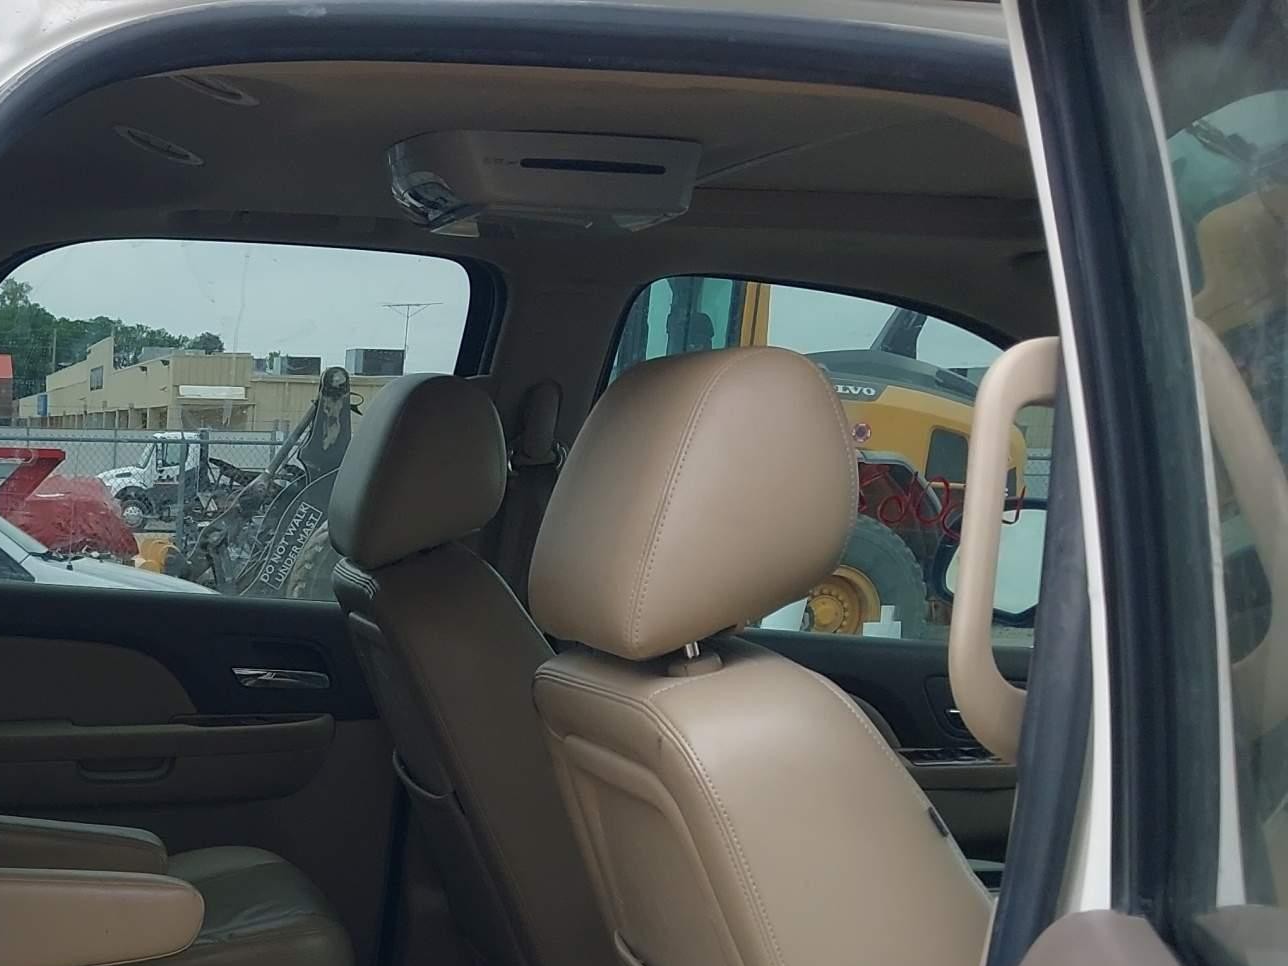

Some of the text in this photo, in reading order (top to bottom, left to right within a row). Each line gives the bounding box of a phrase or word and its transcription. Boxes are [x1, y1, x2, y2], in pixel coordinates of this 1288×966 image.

[833, 384, 876, 396] LVO
[261, 504, 309, 582] DO NOT WALK
[275, 513, 319, 582] UNDER MAST
